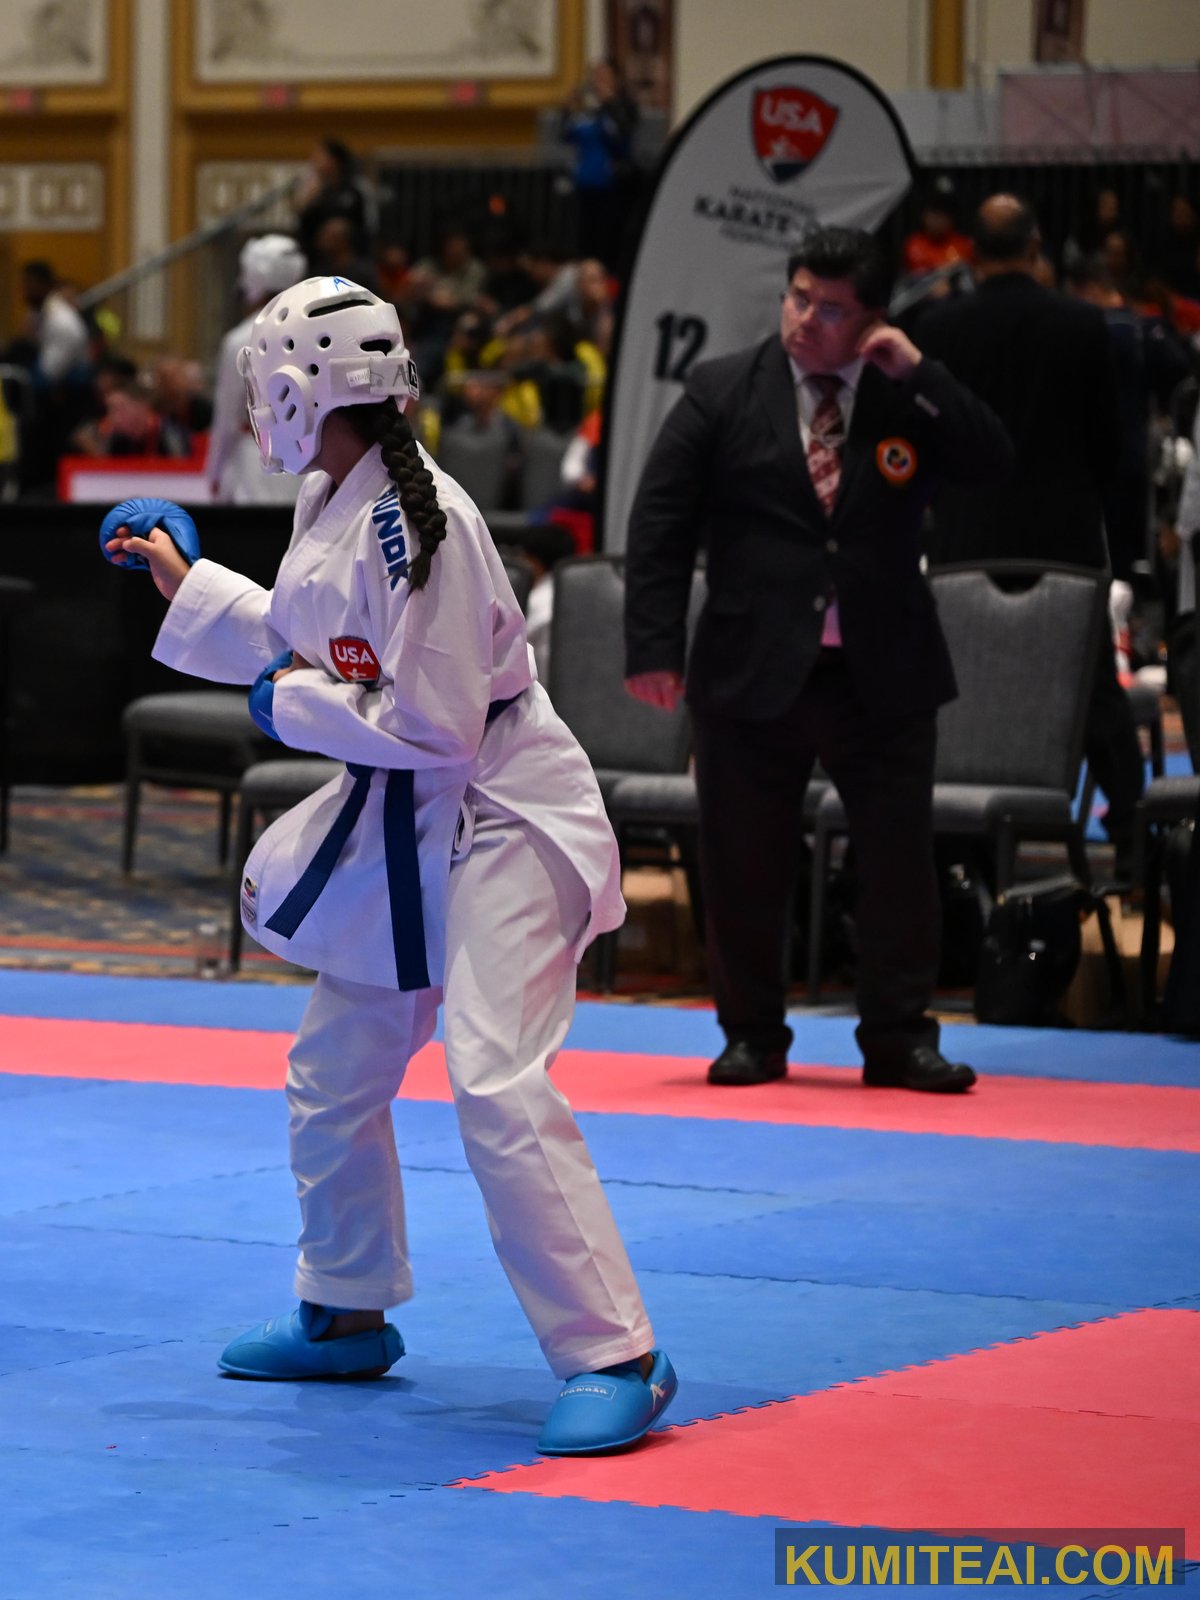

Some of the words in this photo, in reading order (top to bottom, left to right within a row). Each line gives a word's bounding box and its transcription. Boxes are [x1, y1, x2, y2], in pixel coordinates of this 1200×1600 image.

[759, 96, 823, 135] USA
[655, 310, 708, 382] 12
[334, 644, 375, 665] USA
